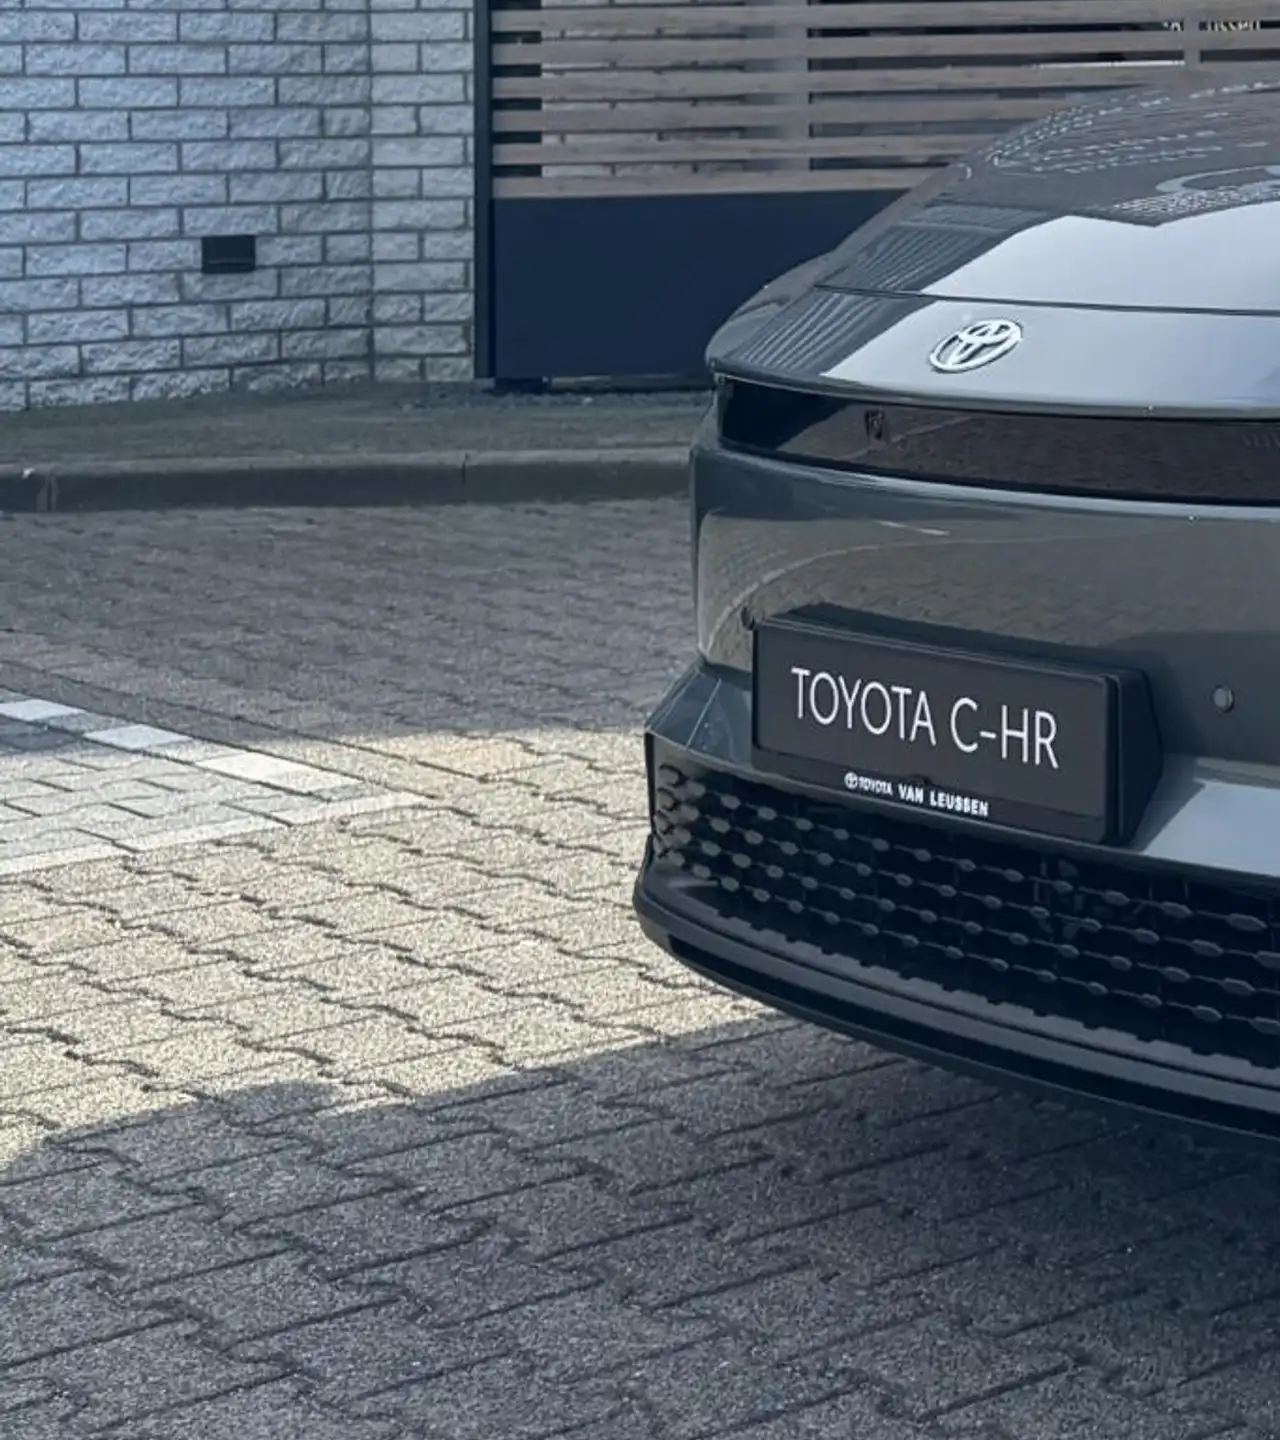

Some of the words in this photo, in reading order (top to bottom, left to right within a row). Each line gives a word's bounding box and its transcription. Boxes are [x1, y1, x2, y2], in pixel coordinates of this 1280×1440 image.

[790, 666, 938, 747] TOYOTA
[949, 696, 1060, 769] C-HR
[897, 783, 924, 805] VAN
[929, 790, 989, 818] LEUSSEN
